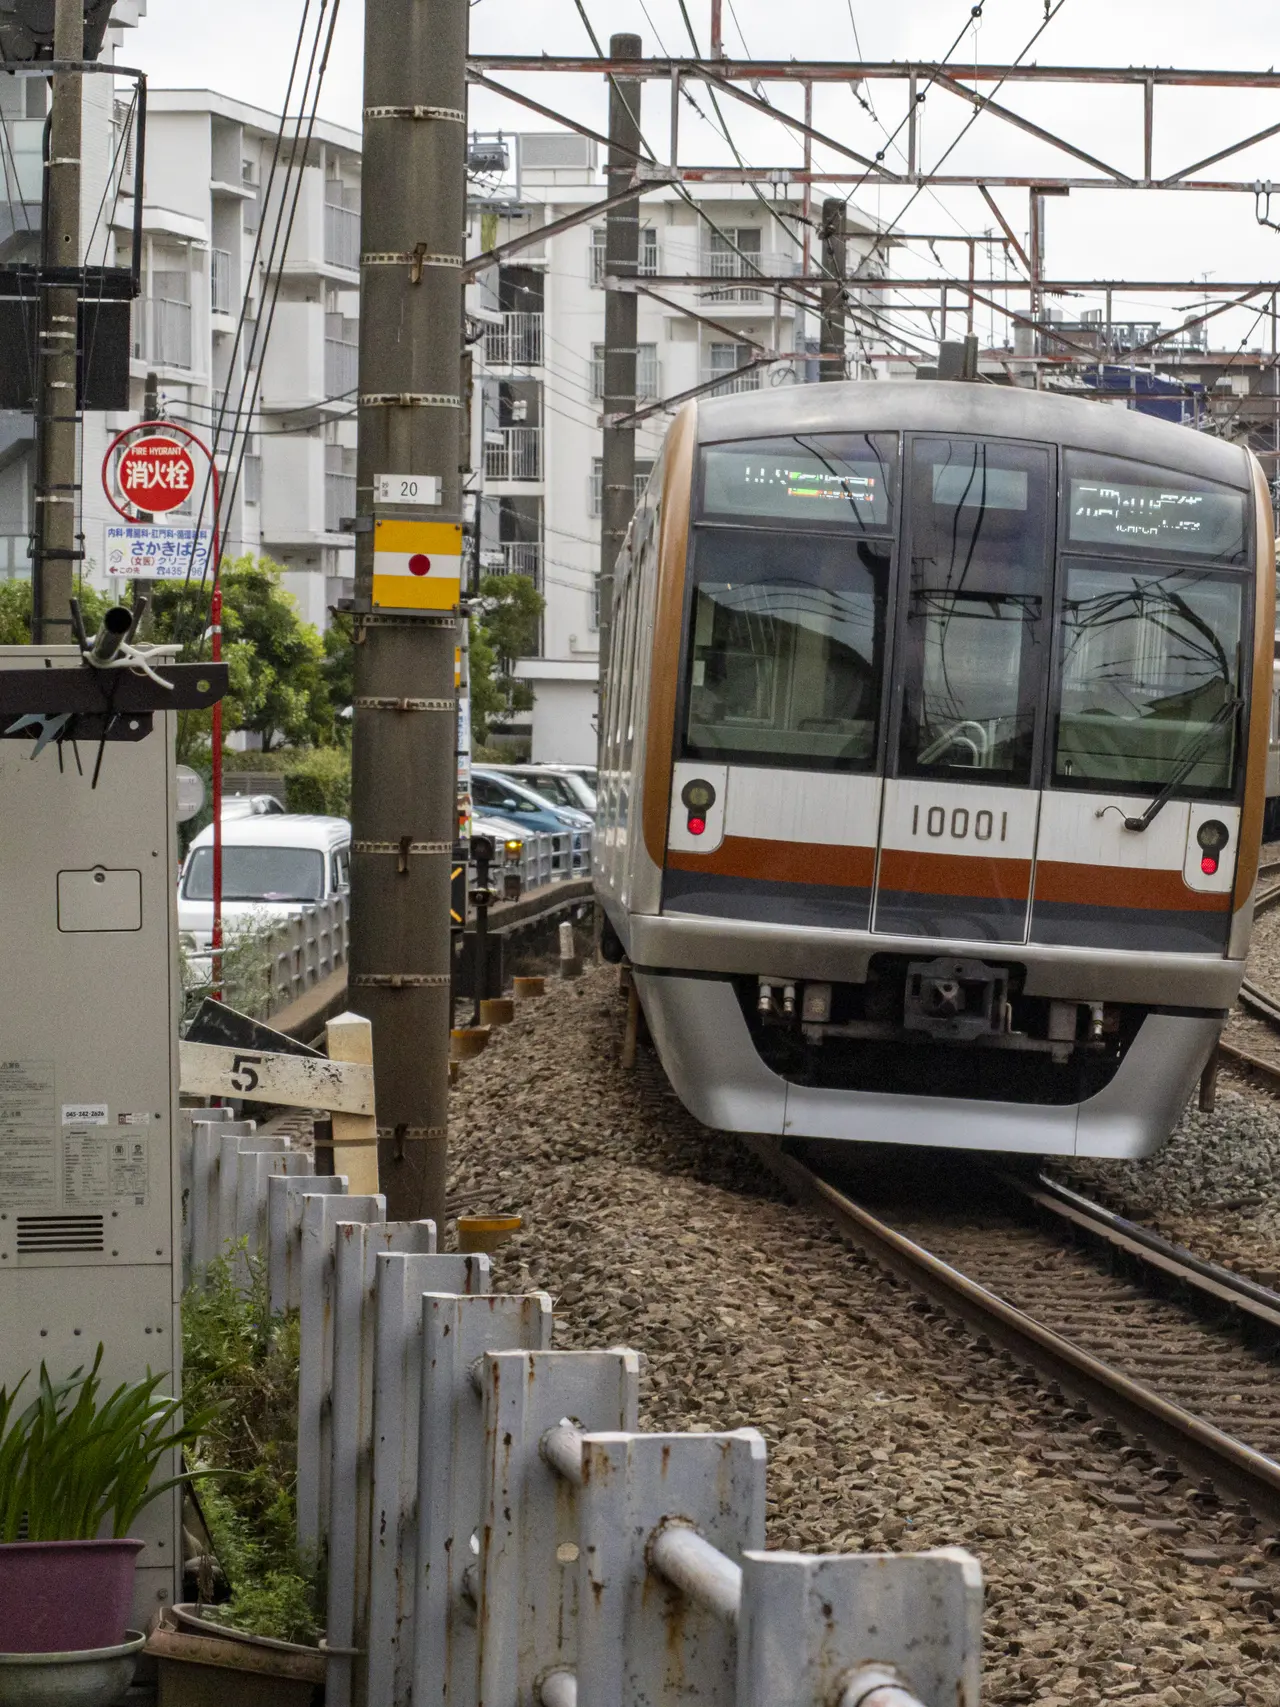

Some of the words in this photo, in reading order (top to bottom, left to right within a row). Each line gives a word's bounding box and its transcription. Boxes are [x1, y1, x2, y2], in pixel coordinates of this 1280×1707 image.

[131, 446, 147, 456] FIRE
[149, 446, 182, 456] HYDRANT
[126, 460, 189, 489] 消火栓
[400, 481, 418, 497] 20
[131, 541, 207, 557] さかきばら
[912, 805, 1008, 841] 10001
[231, 1055, 262, 1092] 5
